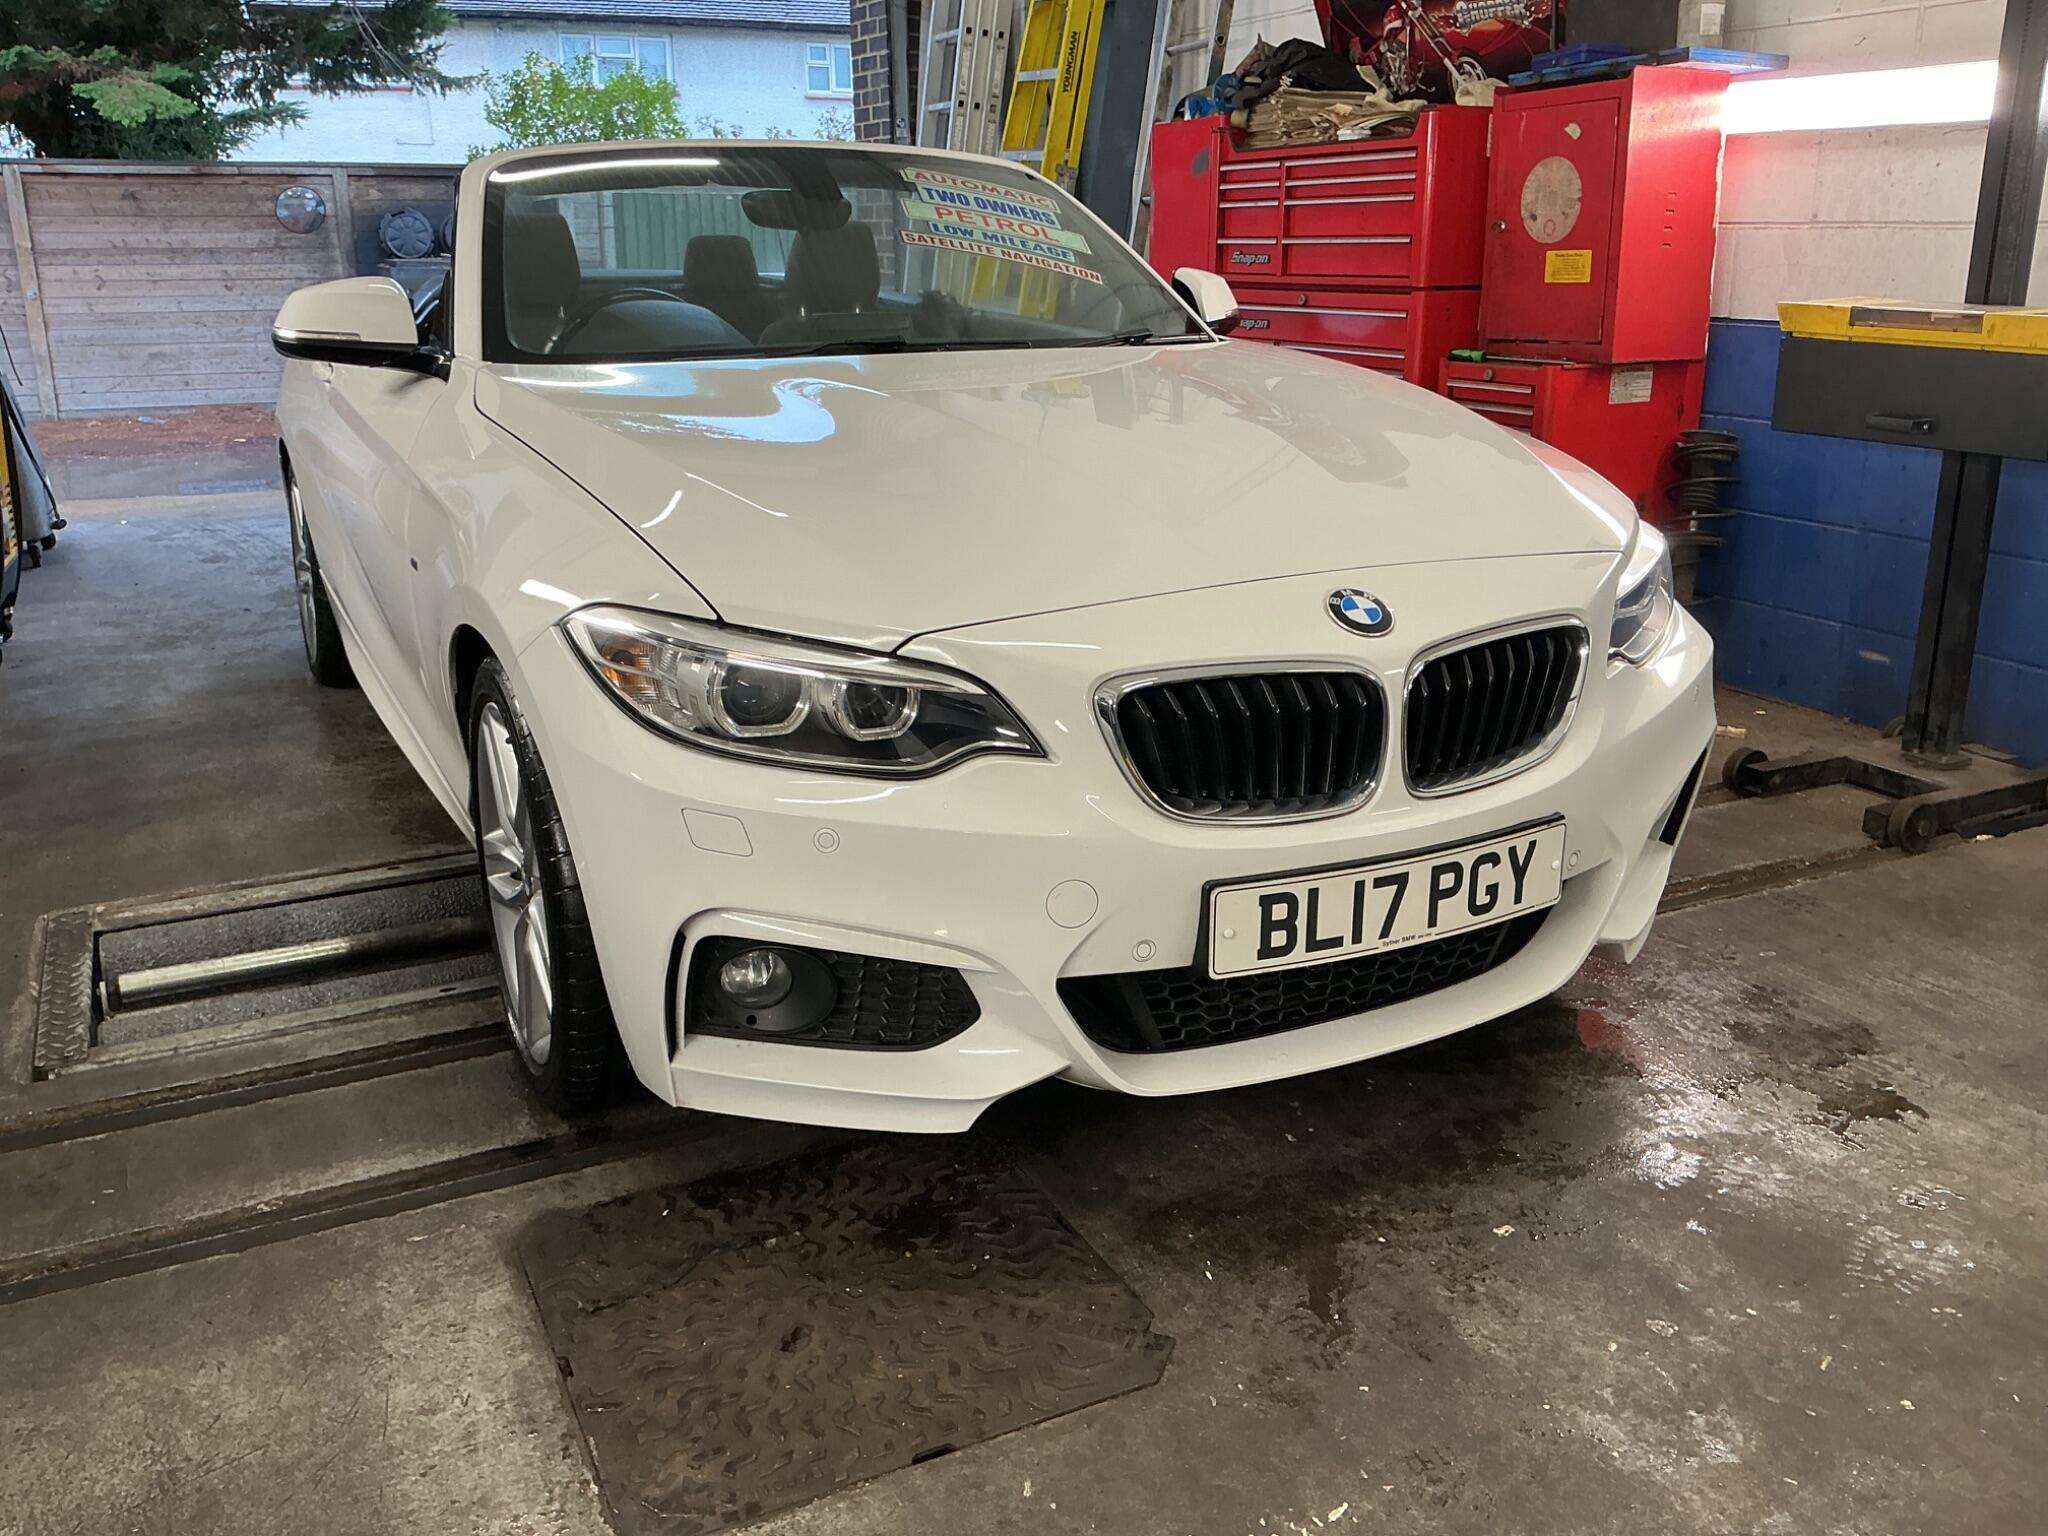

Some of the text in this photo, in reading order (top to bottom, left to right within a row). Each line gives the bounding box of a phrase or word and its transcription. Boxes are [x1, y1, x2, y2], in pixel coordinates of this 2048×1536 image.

[1062, 31, 1079, 93] YOUNGMAN
[914, 171, 1050, 208] AUTOMATIC
[923, 187, 1057, 226] TWO OWNERS
[932, 222, 1075, 260] LOW MILEAGE
[934, 206, 1061, 242] PETROL
[905, 233, 1101, 282] SATELLITE NAVIGATION
[1231, 251, 1268, 266] Snap-on
[1329, 589, 1376, 605] BMW
[1257, 839, 1537, 961] BL17 PGY
[1401, 934, 1416, 942] BMW
